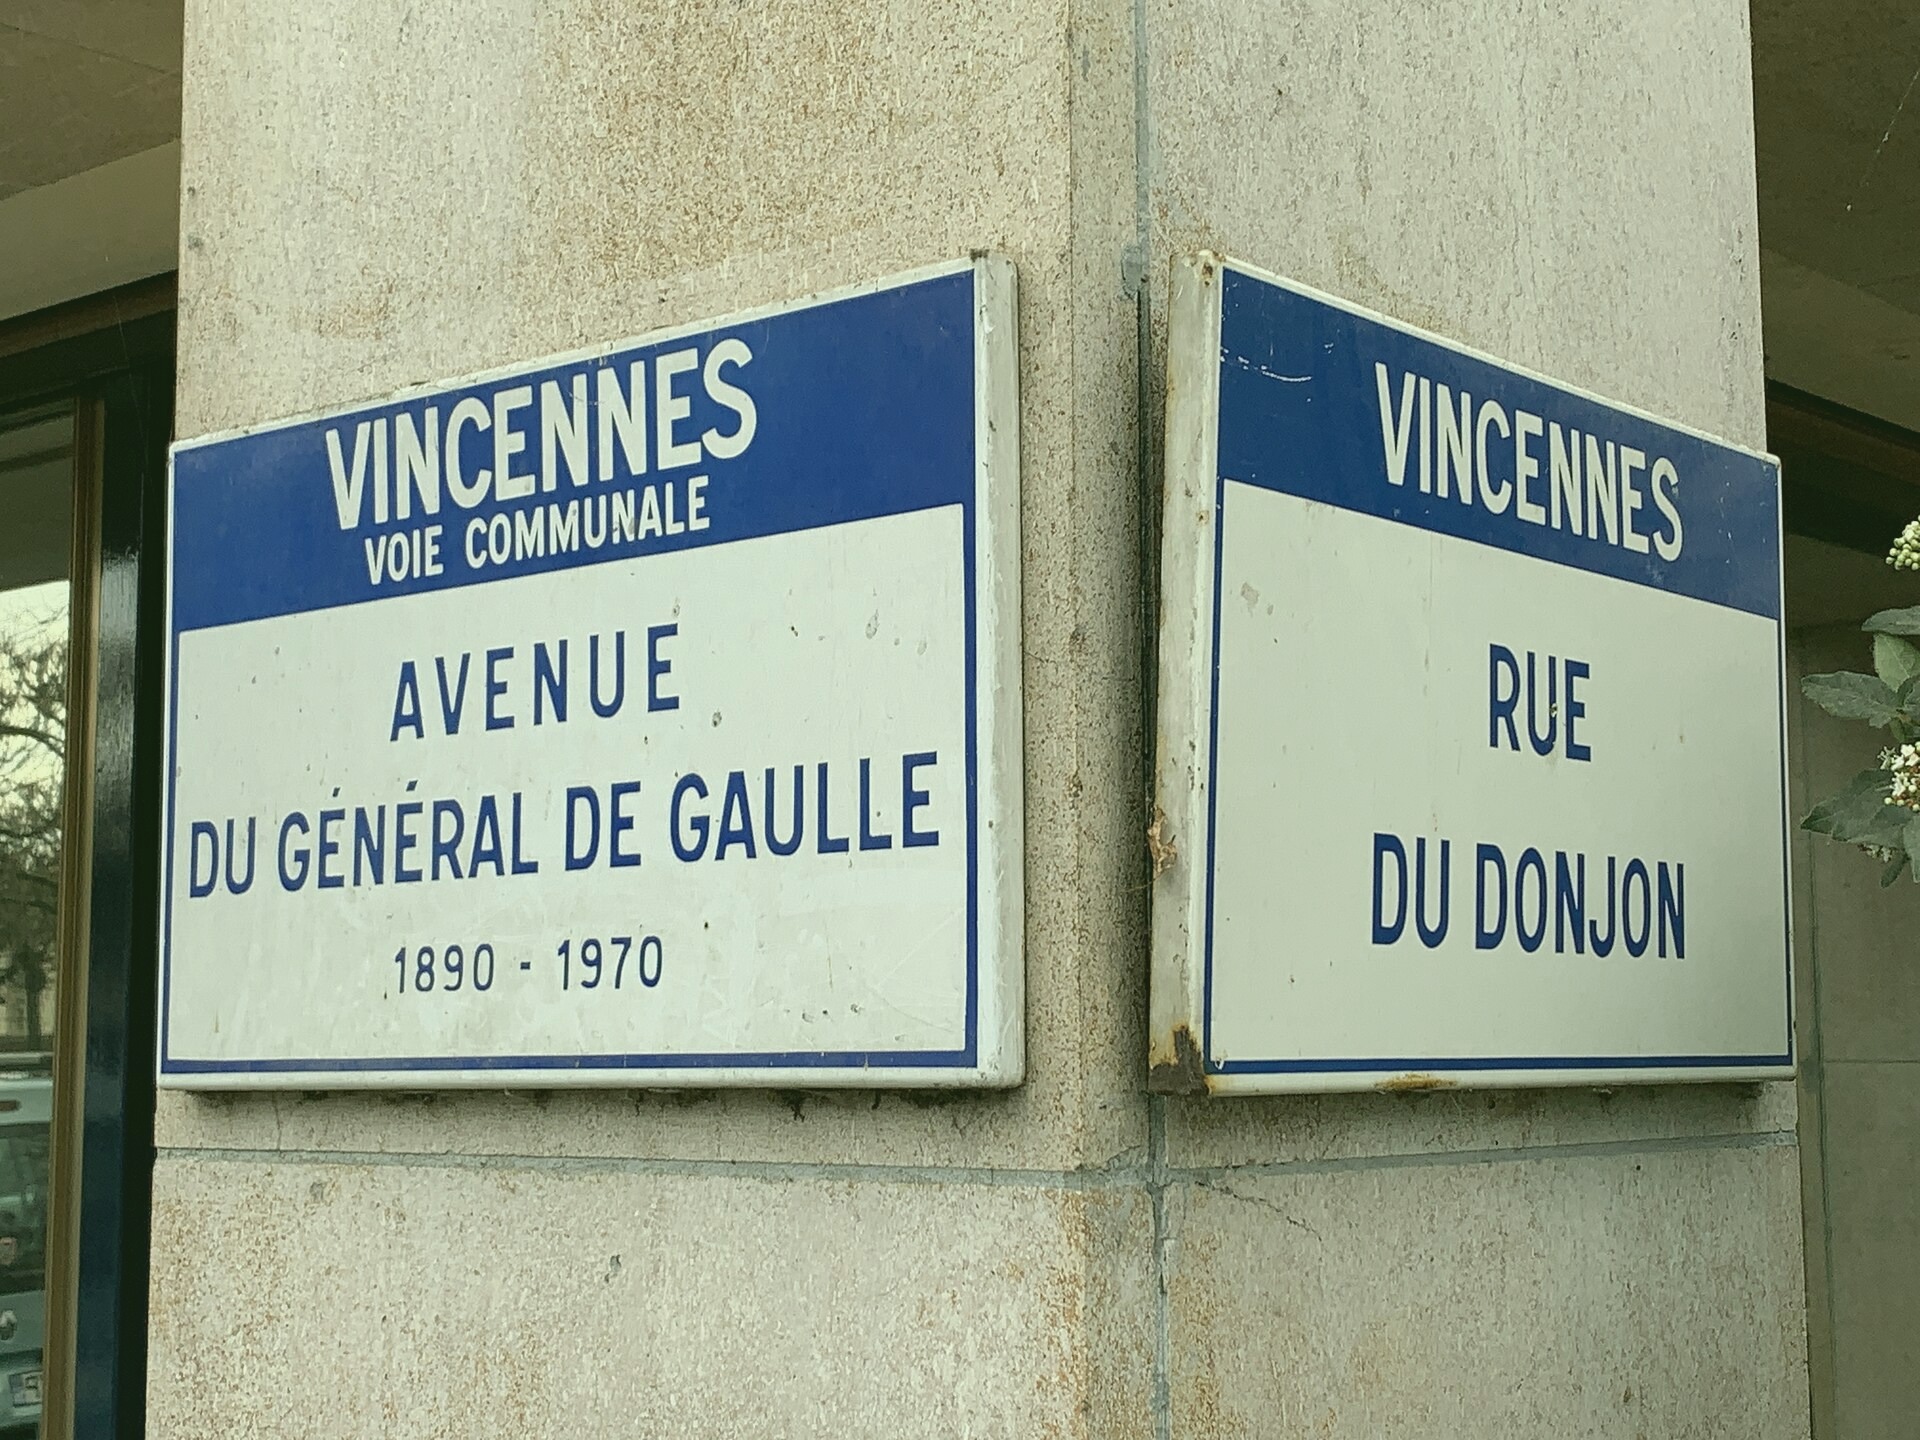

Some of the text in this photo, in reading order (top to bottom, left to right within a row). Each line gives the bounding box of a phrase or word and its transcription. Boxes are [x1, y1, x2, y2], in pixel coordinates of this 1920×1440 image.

[326, 337, 757, 530] VINCENNES
[1374, 362, 1684, 562] VINCENNES
[364, 476, 710, 585] VOIE COMMUNALE
[390, 623, 679, 741] AVENUE
[1490, 643, 1591, 761] RUE
[189, 751, 939, 898] DU GÉNÉRAL DE GAULLE
[1373, 833, 1685, 960] DU DONJON
[393, 935, 663, 992] 1890 - 1970
